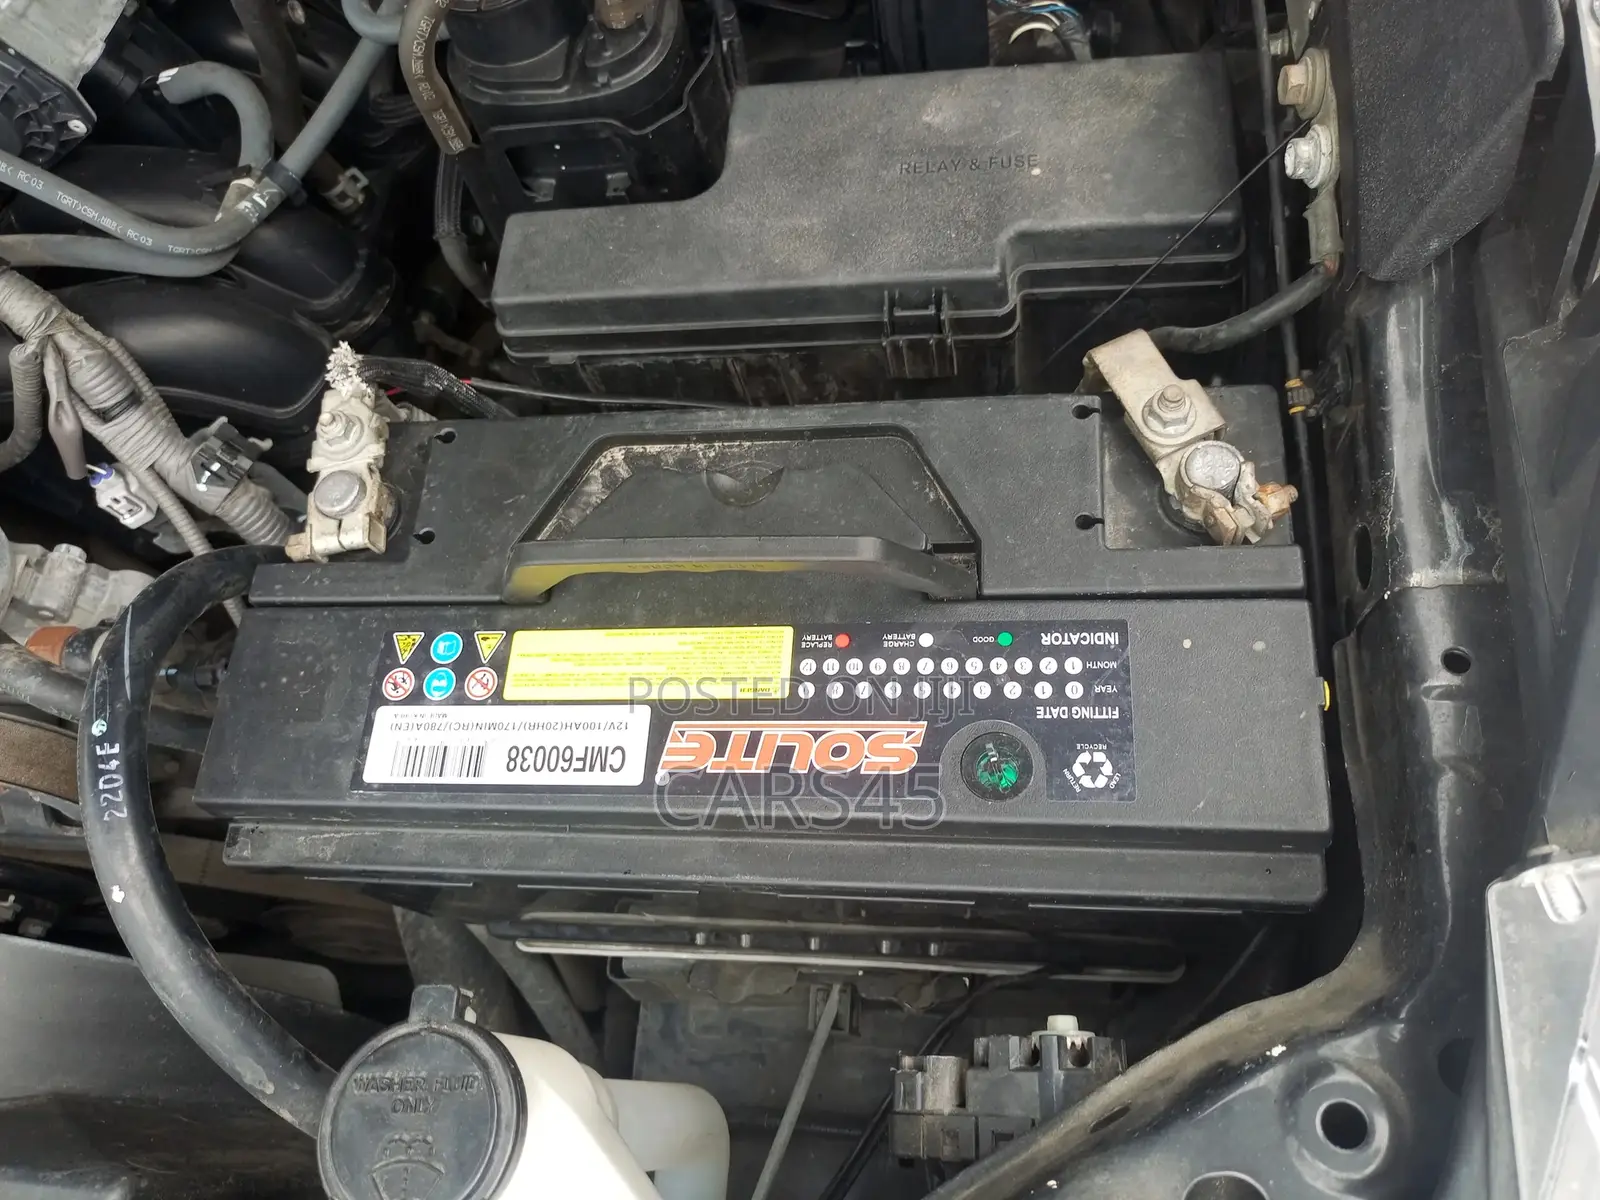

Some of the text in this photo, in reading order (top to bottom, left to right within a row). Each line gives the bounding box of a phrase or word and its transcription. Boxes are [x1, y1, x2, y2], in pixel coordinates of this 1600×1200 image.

[899, 153, 1039, 175] RELAY & FUSE
[801, 641, 833, 649] REPLACE
[972, 635, 995, 644] GOOD
[1040, 631, 1119, 646] INDICATOR
[1086, 660, 1118, 670] MONTH
[1093, 684, 1118, 694] YEAR
[1036, 705, 1119, 719] FITTING DATE
[659, 721, 928, 775] SOLITE
[506, 744, 627, 773] CMF60038
[1062, 768, 1082, 793] RETURN
[1109, 772, 1121, 789] LEAD
[353, 1071, 480, 1094] WASHER FLUID
[391, 1095, 438, 1114] ONLY
